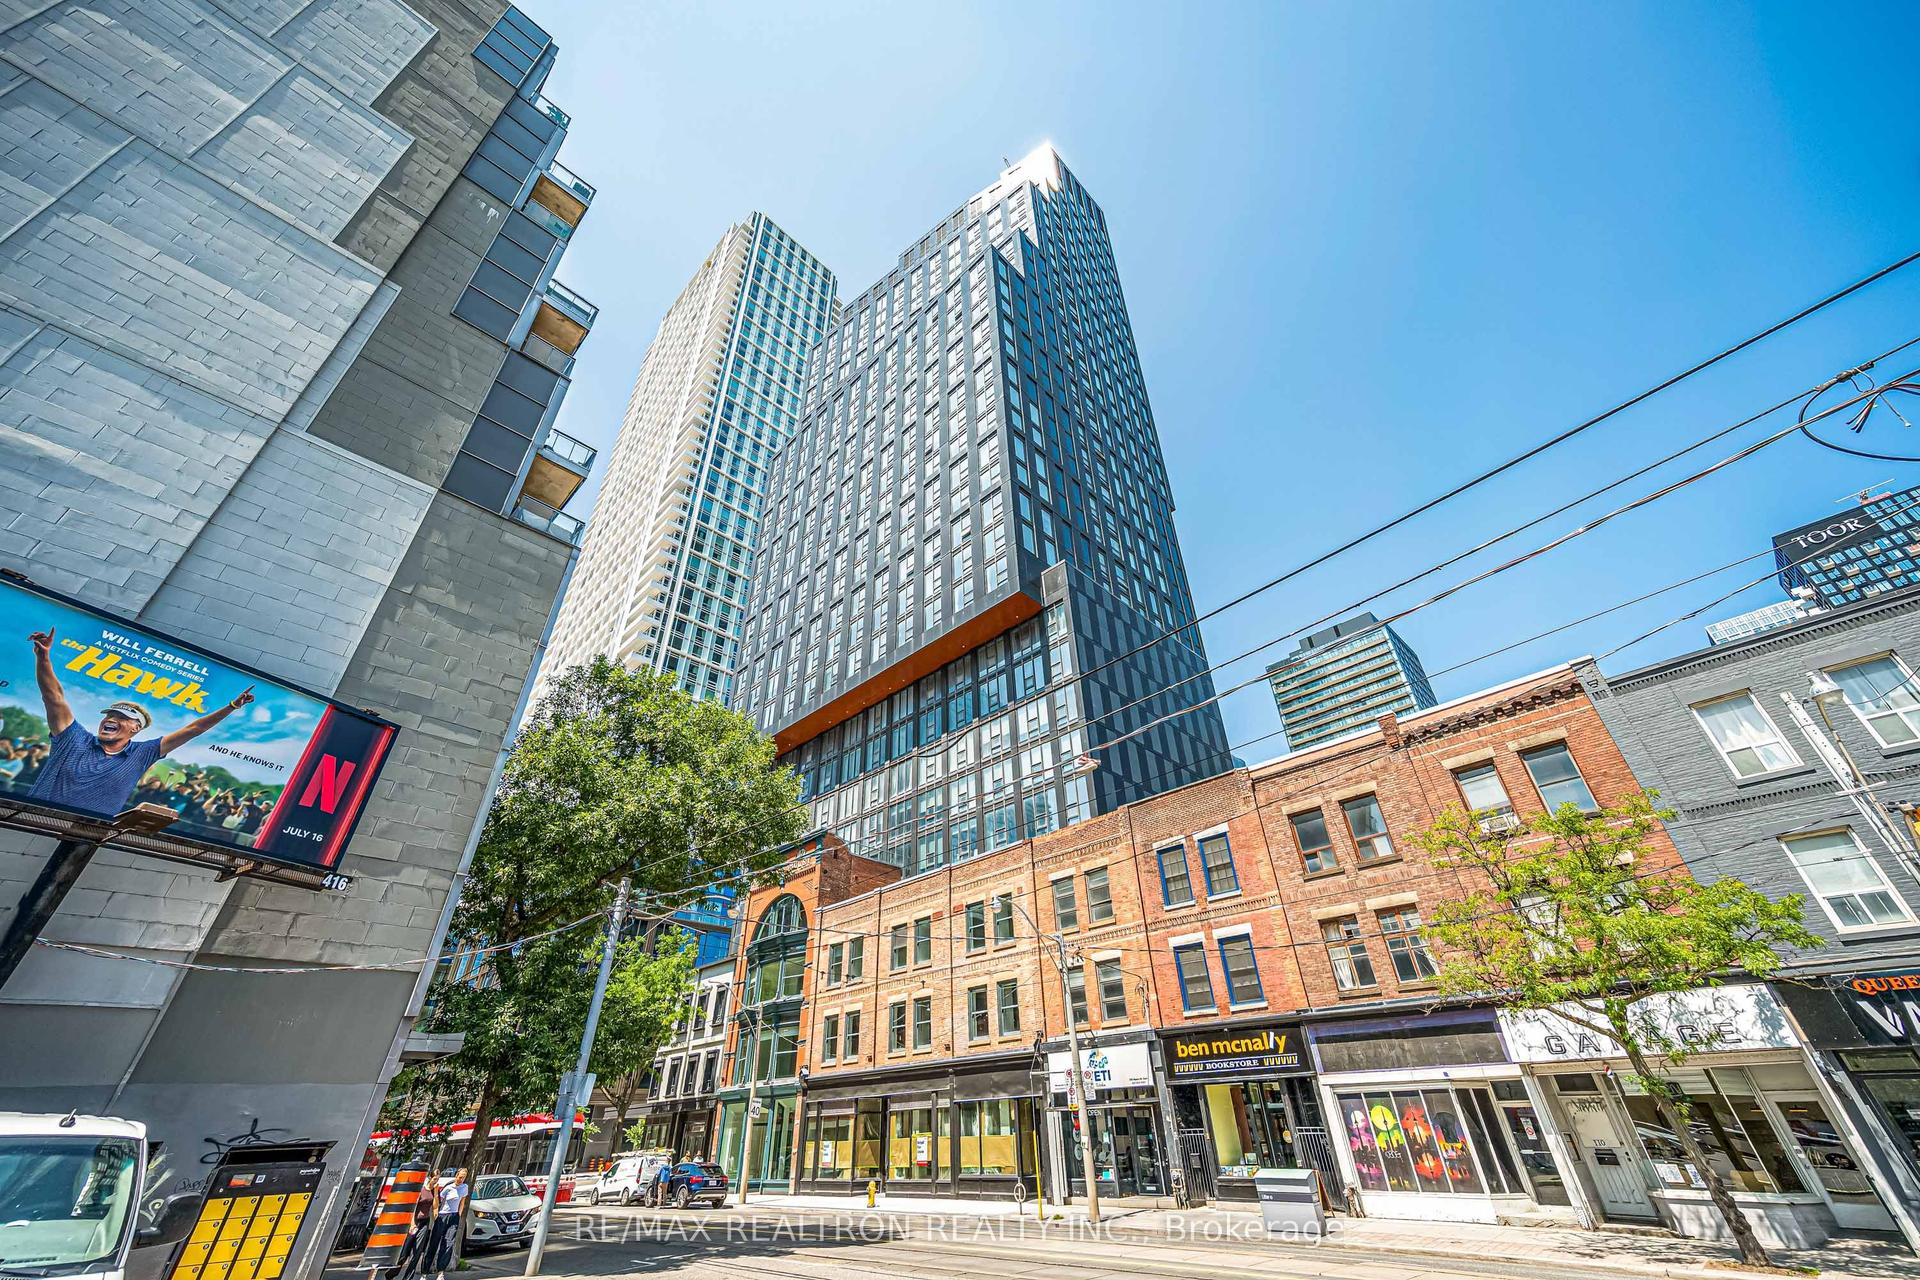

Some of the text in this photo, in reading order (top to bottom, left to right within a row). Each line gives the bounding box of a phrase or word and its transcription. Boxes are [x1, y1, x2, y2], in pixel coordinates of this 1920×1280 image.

[1791, 519, 1865, 548] TOOR
[102, 630, 209, 676] WILL FERRELL
[103, 643, 139, 660] NETFLIX
[141, 656, 176, 673] COMEDY
[177, 668, 205, 683] SERIES
[65, 646, 209, 713] Hawk
[209, 744, 285, 772] AND HE KNOWS IT
[298, 753, 356, 815] N
[283, 826, 324, 842] JULY 16
[322, 874, 349, 891] 416
[1852, 975, 1920, 996] QUEE
[1176, 1031, 1287, 1058] ben mcnally
[1545, 1022, 1742, 1055] GAAGE
[1092, 1069, 1111, 1082] ETI
[1205, 1059, 1259, 1070] BOOKSTORE
[751, 1106, 760, 1115] 40
